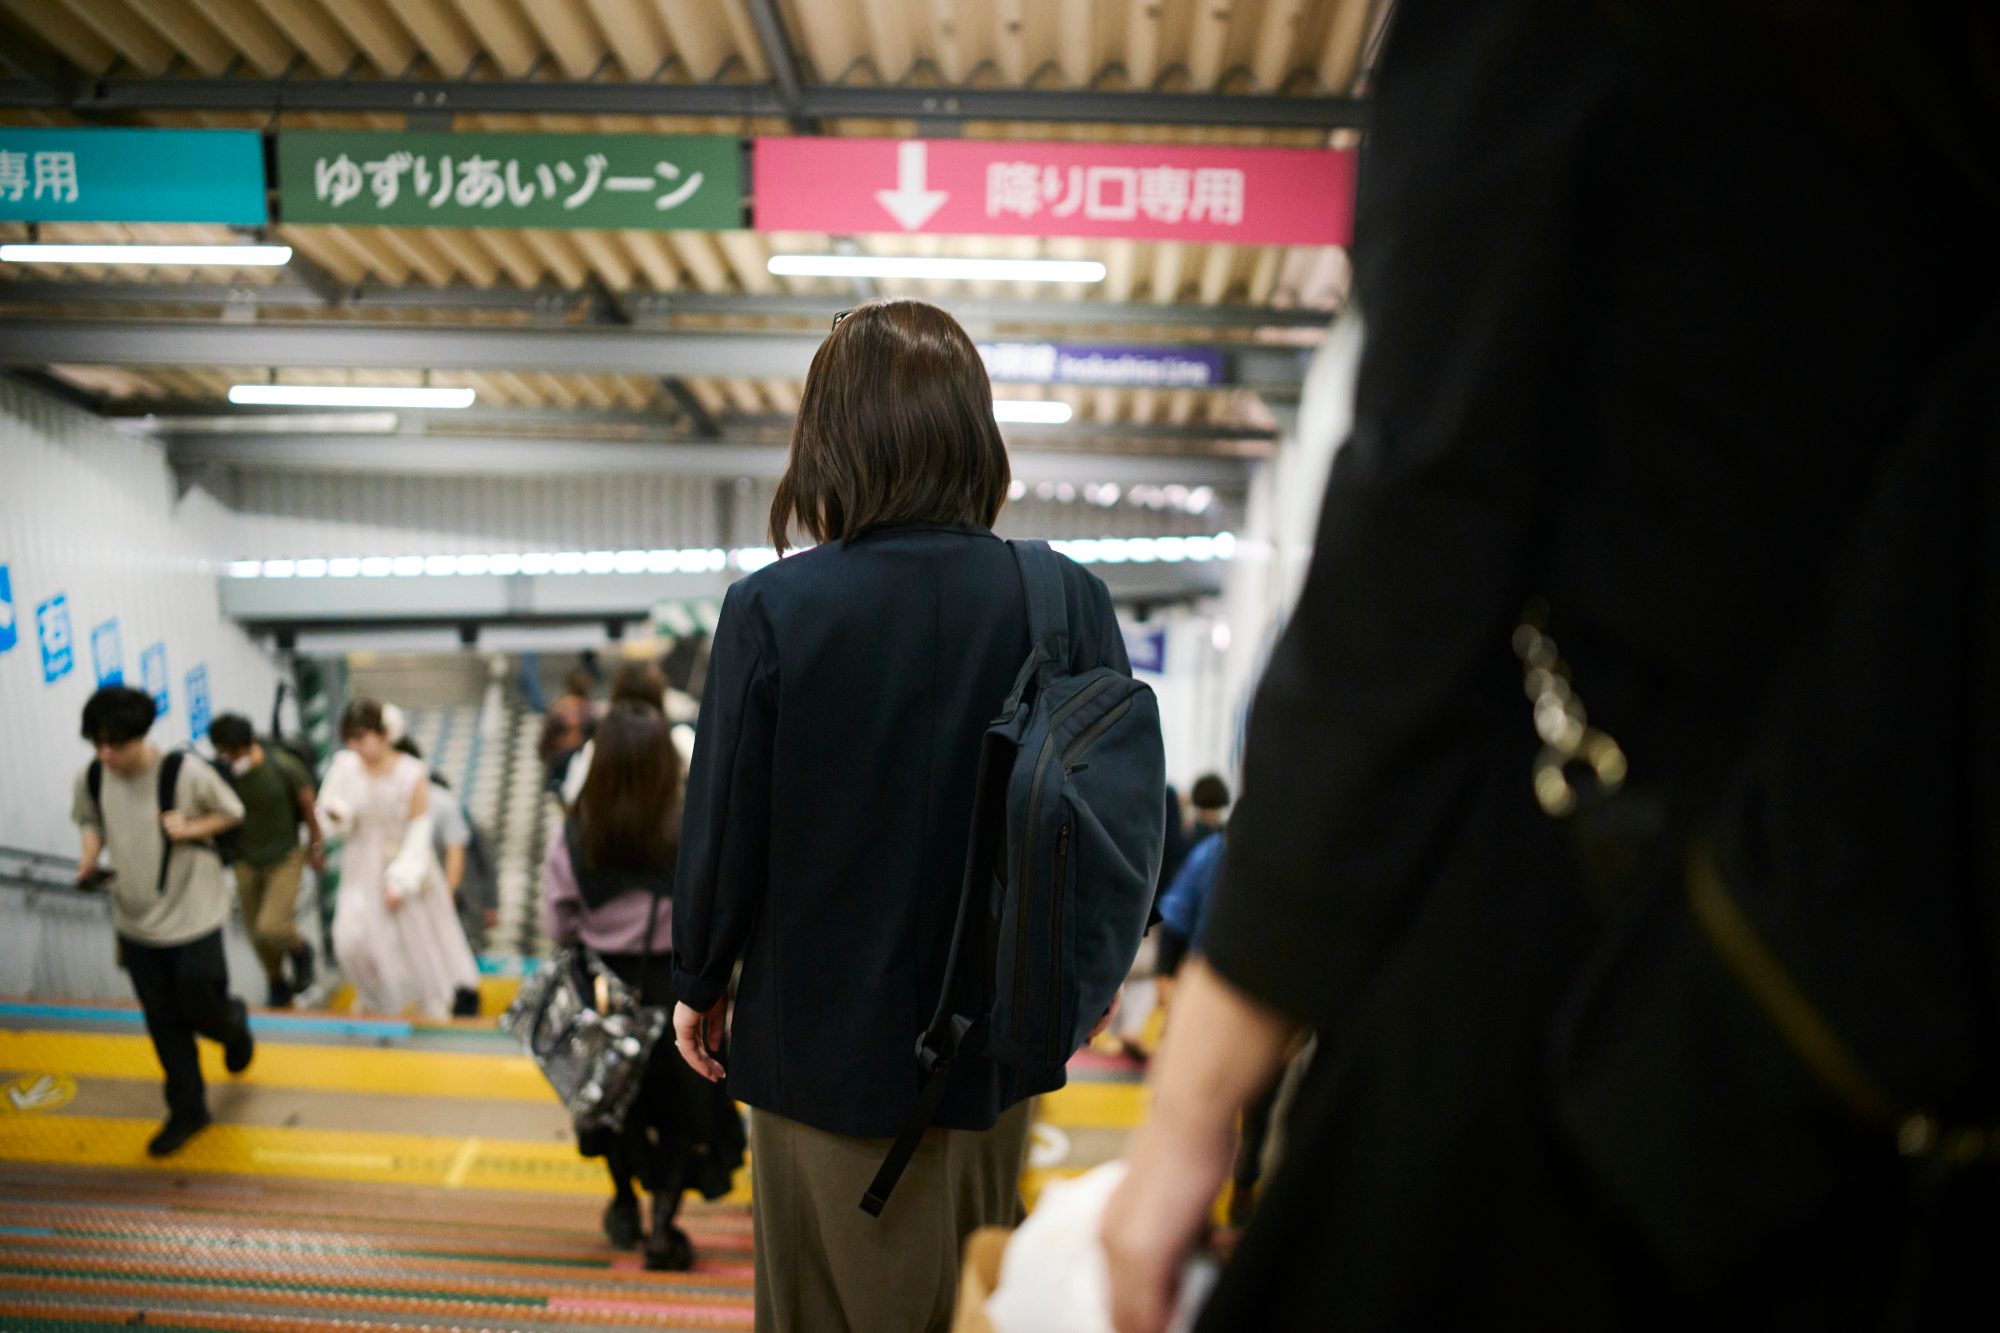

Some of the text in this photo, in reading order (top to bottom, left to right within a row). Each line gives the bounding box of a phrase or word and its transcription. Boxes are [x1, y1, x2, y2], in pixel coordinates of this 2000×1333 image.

[314, 151, 704, 210] ゆずりあいゾーン
[985, 161, 1246, 225] 降り口専用
